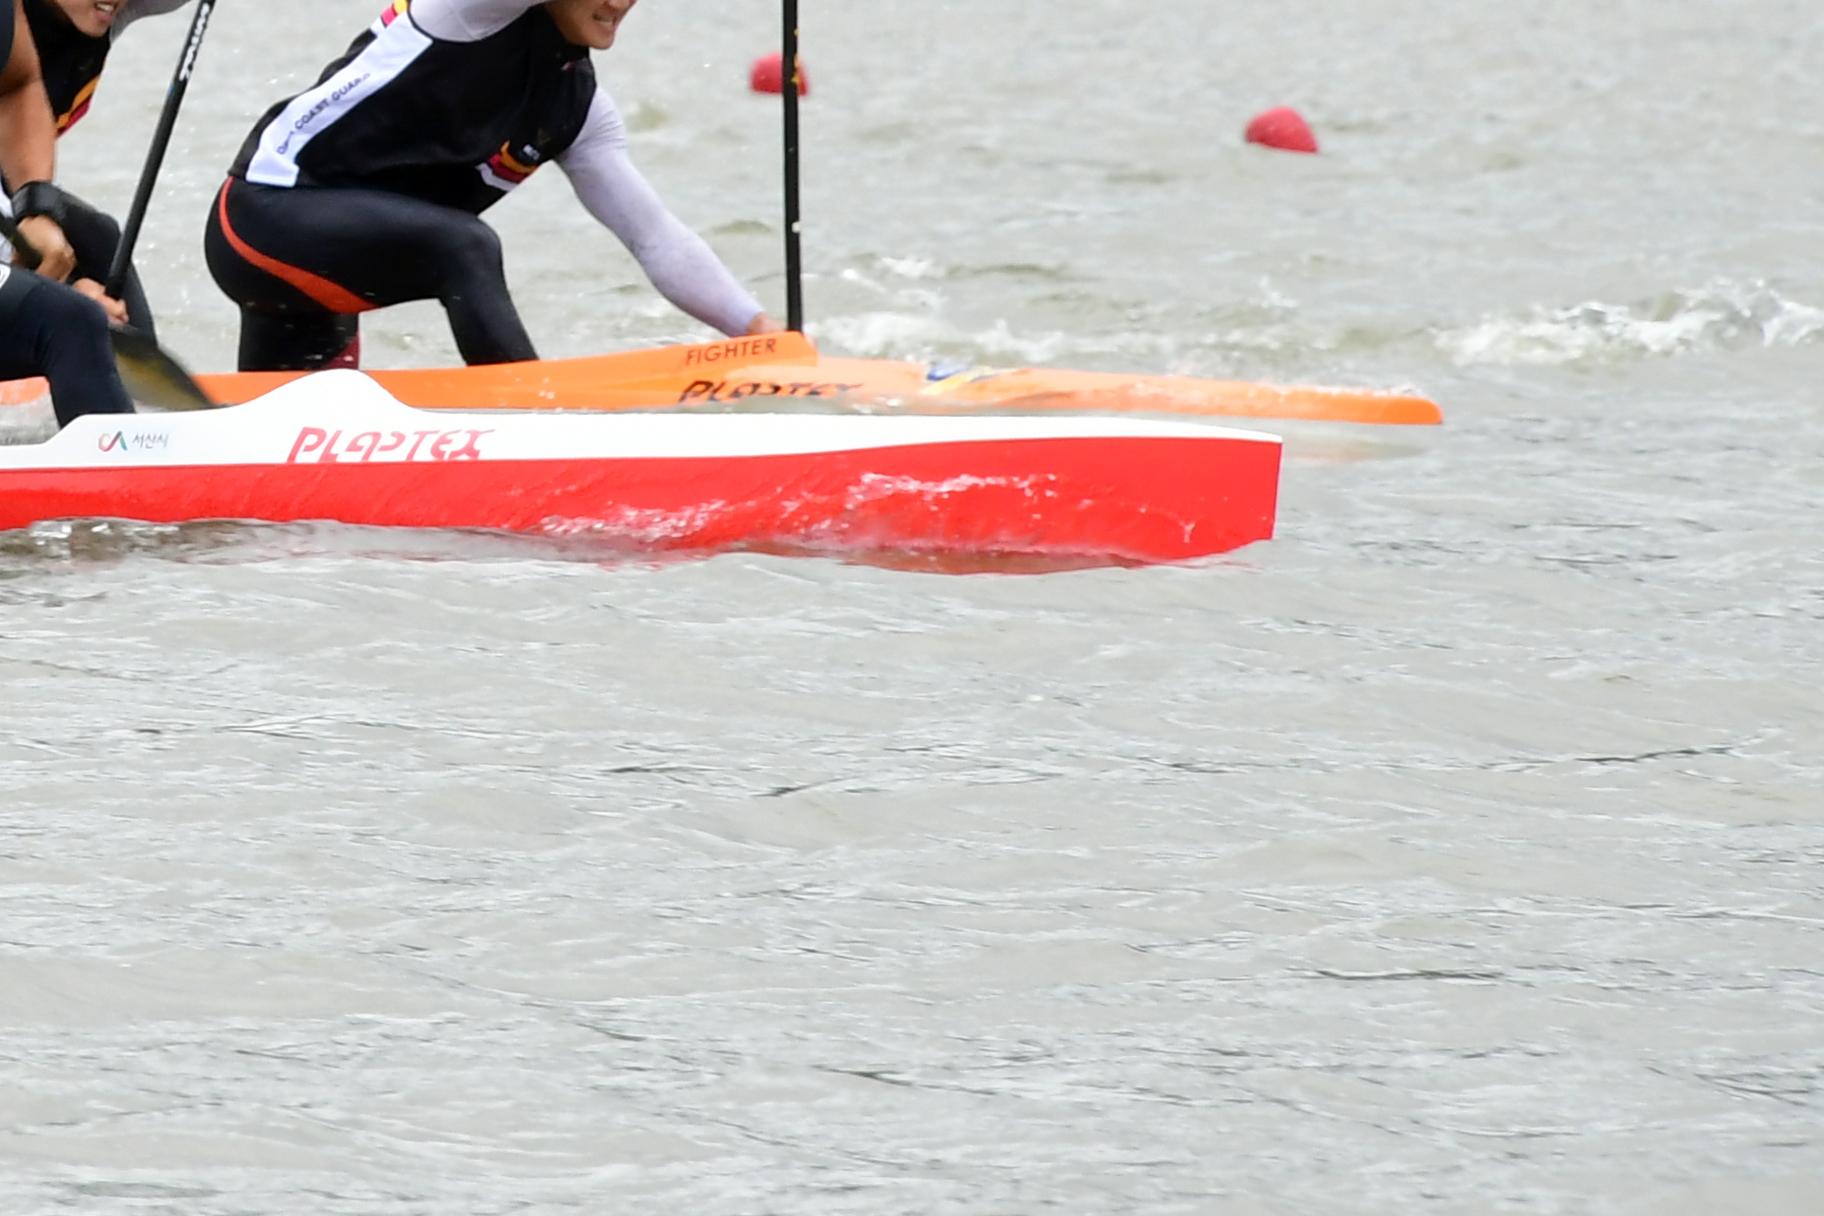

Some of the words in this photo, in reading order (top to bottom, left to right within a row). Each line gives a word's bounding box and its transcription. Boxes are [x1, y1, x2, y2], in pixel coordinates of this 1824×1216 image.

[294, 98, 329, 130] COAST
[685, 338, 777, 366] FIGHTER
[286, 426, 497, 464] PLASTEX
